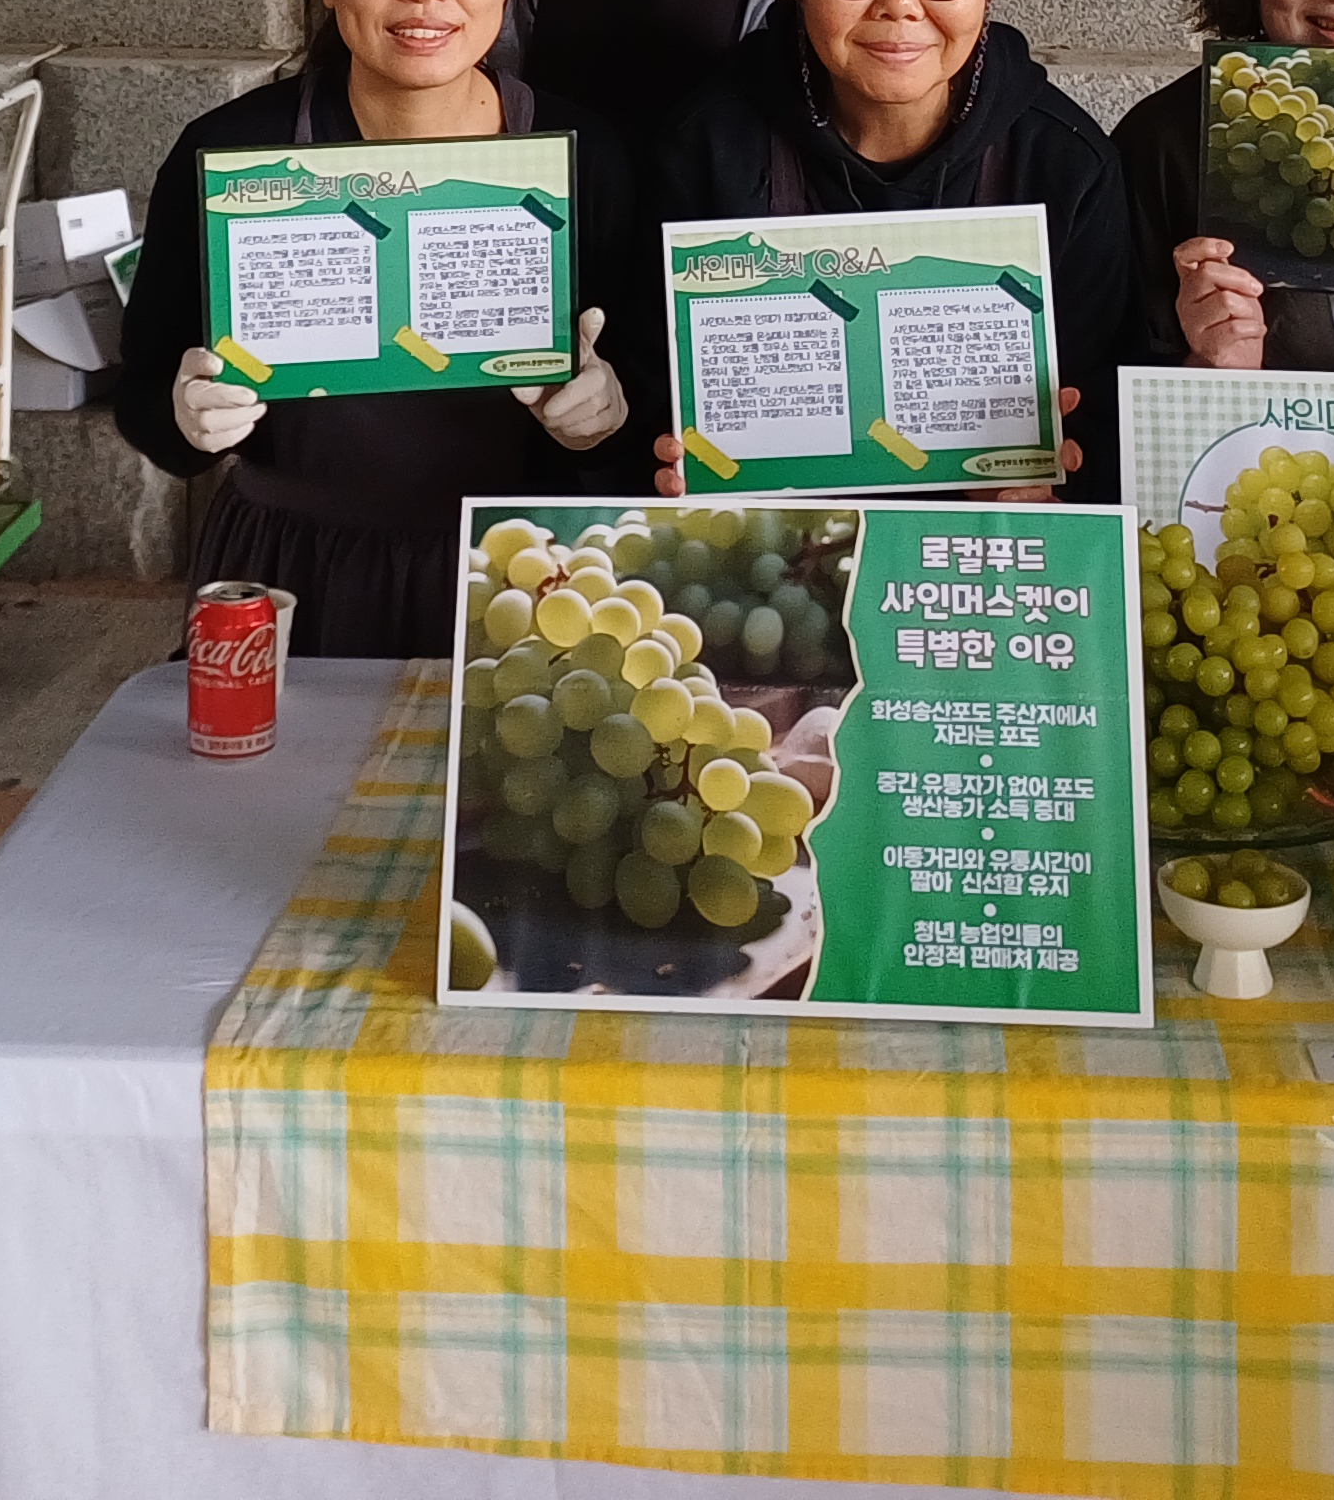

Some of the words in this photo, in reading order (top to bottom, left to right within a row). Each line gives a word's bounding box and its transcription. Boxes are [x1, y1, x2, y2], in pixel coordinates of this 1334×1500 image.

[220, 174, 341, 204] 샤인머스켓
[348, 170, 422, 200] Q&A
[681, 251, 804, 283] 샤인머스켓
[813, 246, 891, 276] Q&A
[920, 536, 1047, 573] 로컬푸드
[878, 581, 1090, 624] 샤인머스켓이
[894, 630, 996, 671] 특별한
[1007, 633, 1076, 671] 이유
[870, 699, 993, 723] 화성송산포도
[995, 702, 1098, 728] 주산지에서
[932, 723, 995, 746] 자라는
[998, 725, 1041, 747] 포도
[875, 771, 918, 794] 중간
[921, 772, 1005, 797] 유통자가
[1007, 775, 1049, 798] 없어
[1052, 777, 1096, 799] 포도
[901, 795, 986, 819] 생산농가
[987, 798, 1030, 822] 소득
[1033, 799, 1076, 823] 증대
[882, 845, 986, 870] 이동거리와
[988, 848, 1093, 875] 유통시간이
[961, 871, 1024, 896] 신선함
[1027, 874, 1070, 898] 유지
[913, 920, 956, 943] 청년
[902, 943, 966, 968] 안정적
[969, 946, 1033, 971] 판매처
[1036, 948, 1080, 973] 제공
